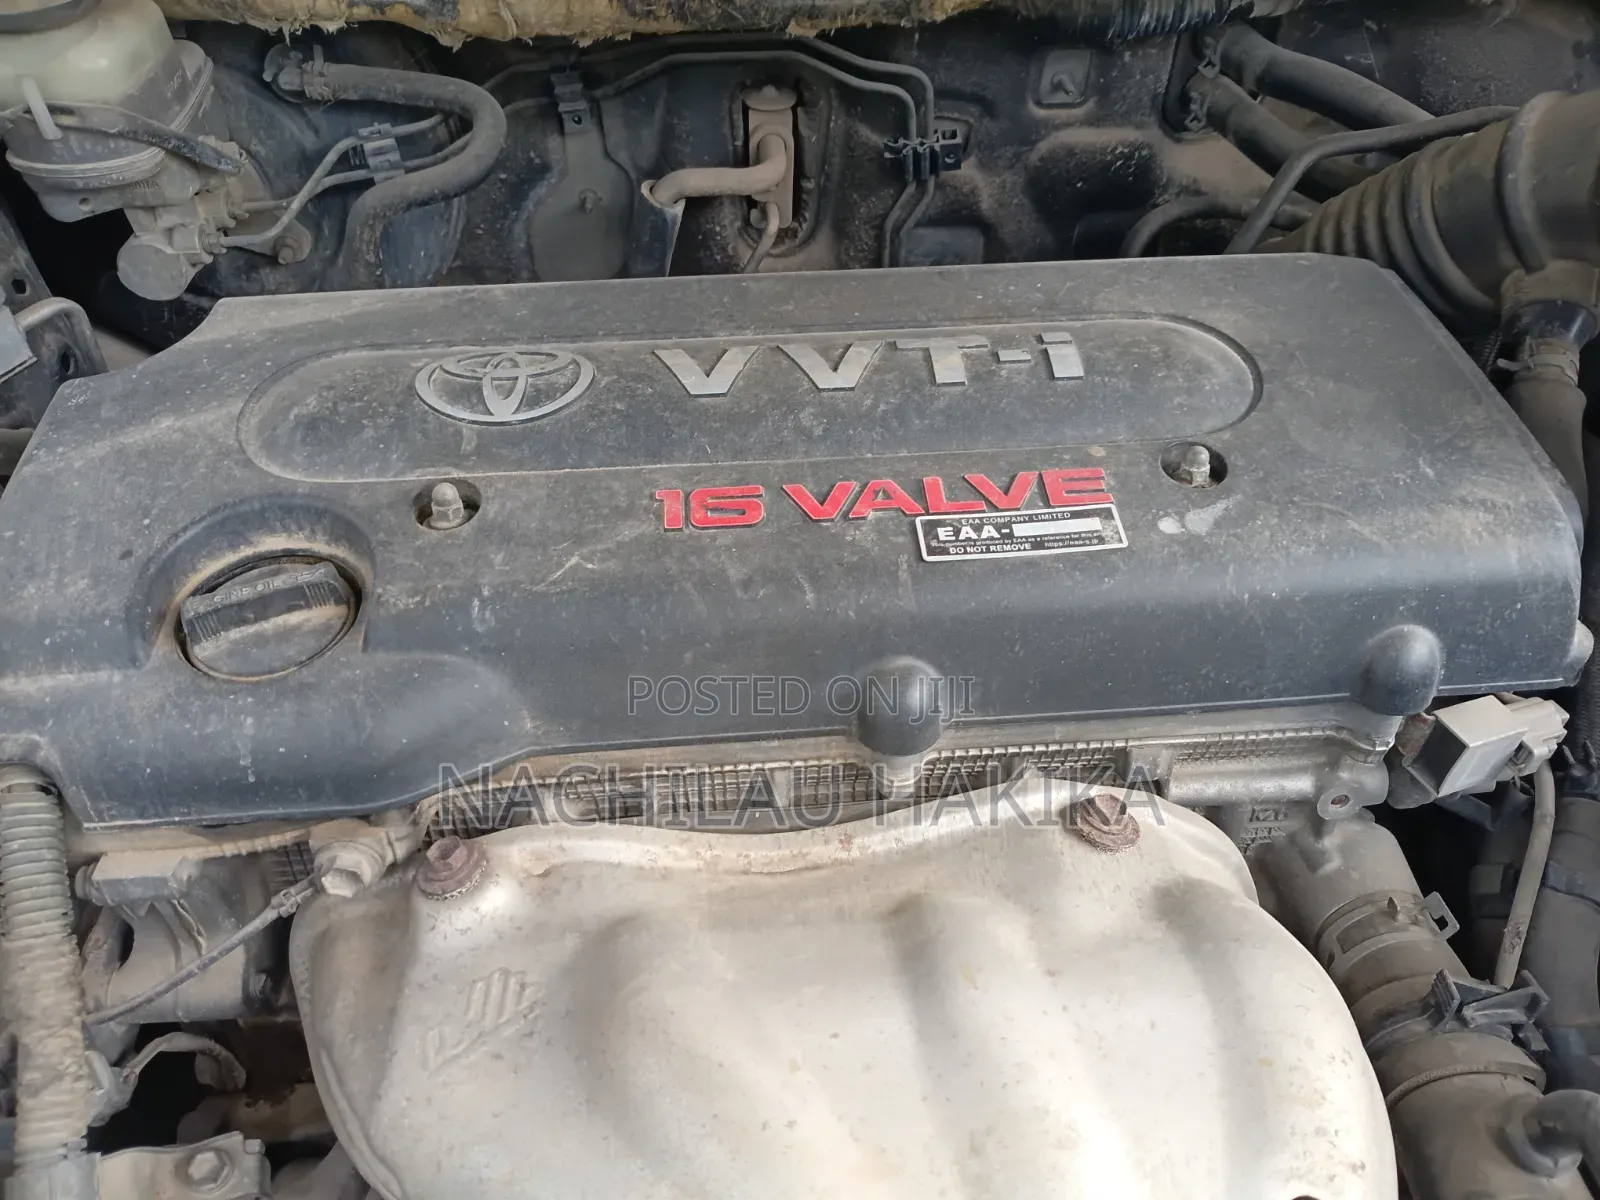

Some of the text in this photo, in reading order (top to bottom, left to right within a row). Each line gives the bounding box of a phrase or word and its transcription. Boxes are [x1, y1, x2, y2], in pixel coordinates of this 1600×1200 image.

[652, 330, 1085, 398] VVT-i
[655, 467, 1115, 530] 16 VALVE
[983, 515, 1029, 524] COMPANY
[1033, 512, 1071, 520] LIMITED
[949, 547, 964, 555] DO
[990, 543, 1032, 552] REMOVE
